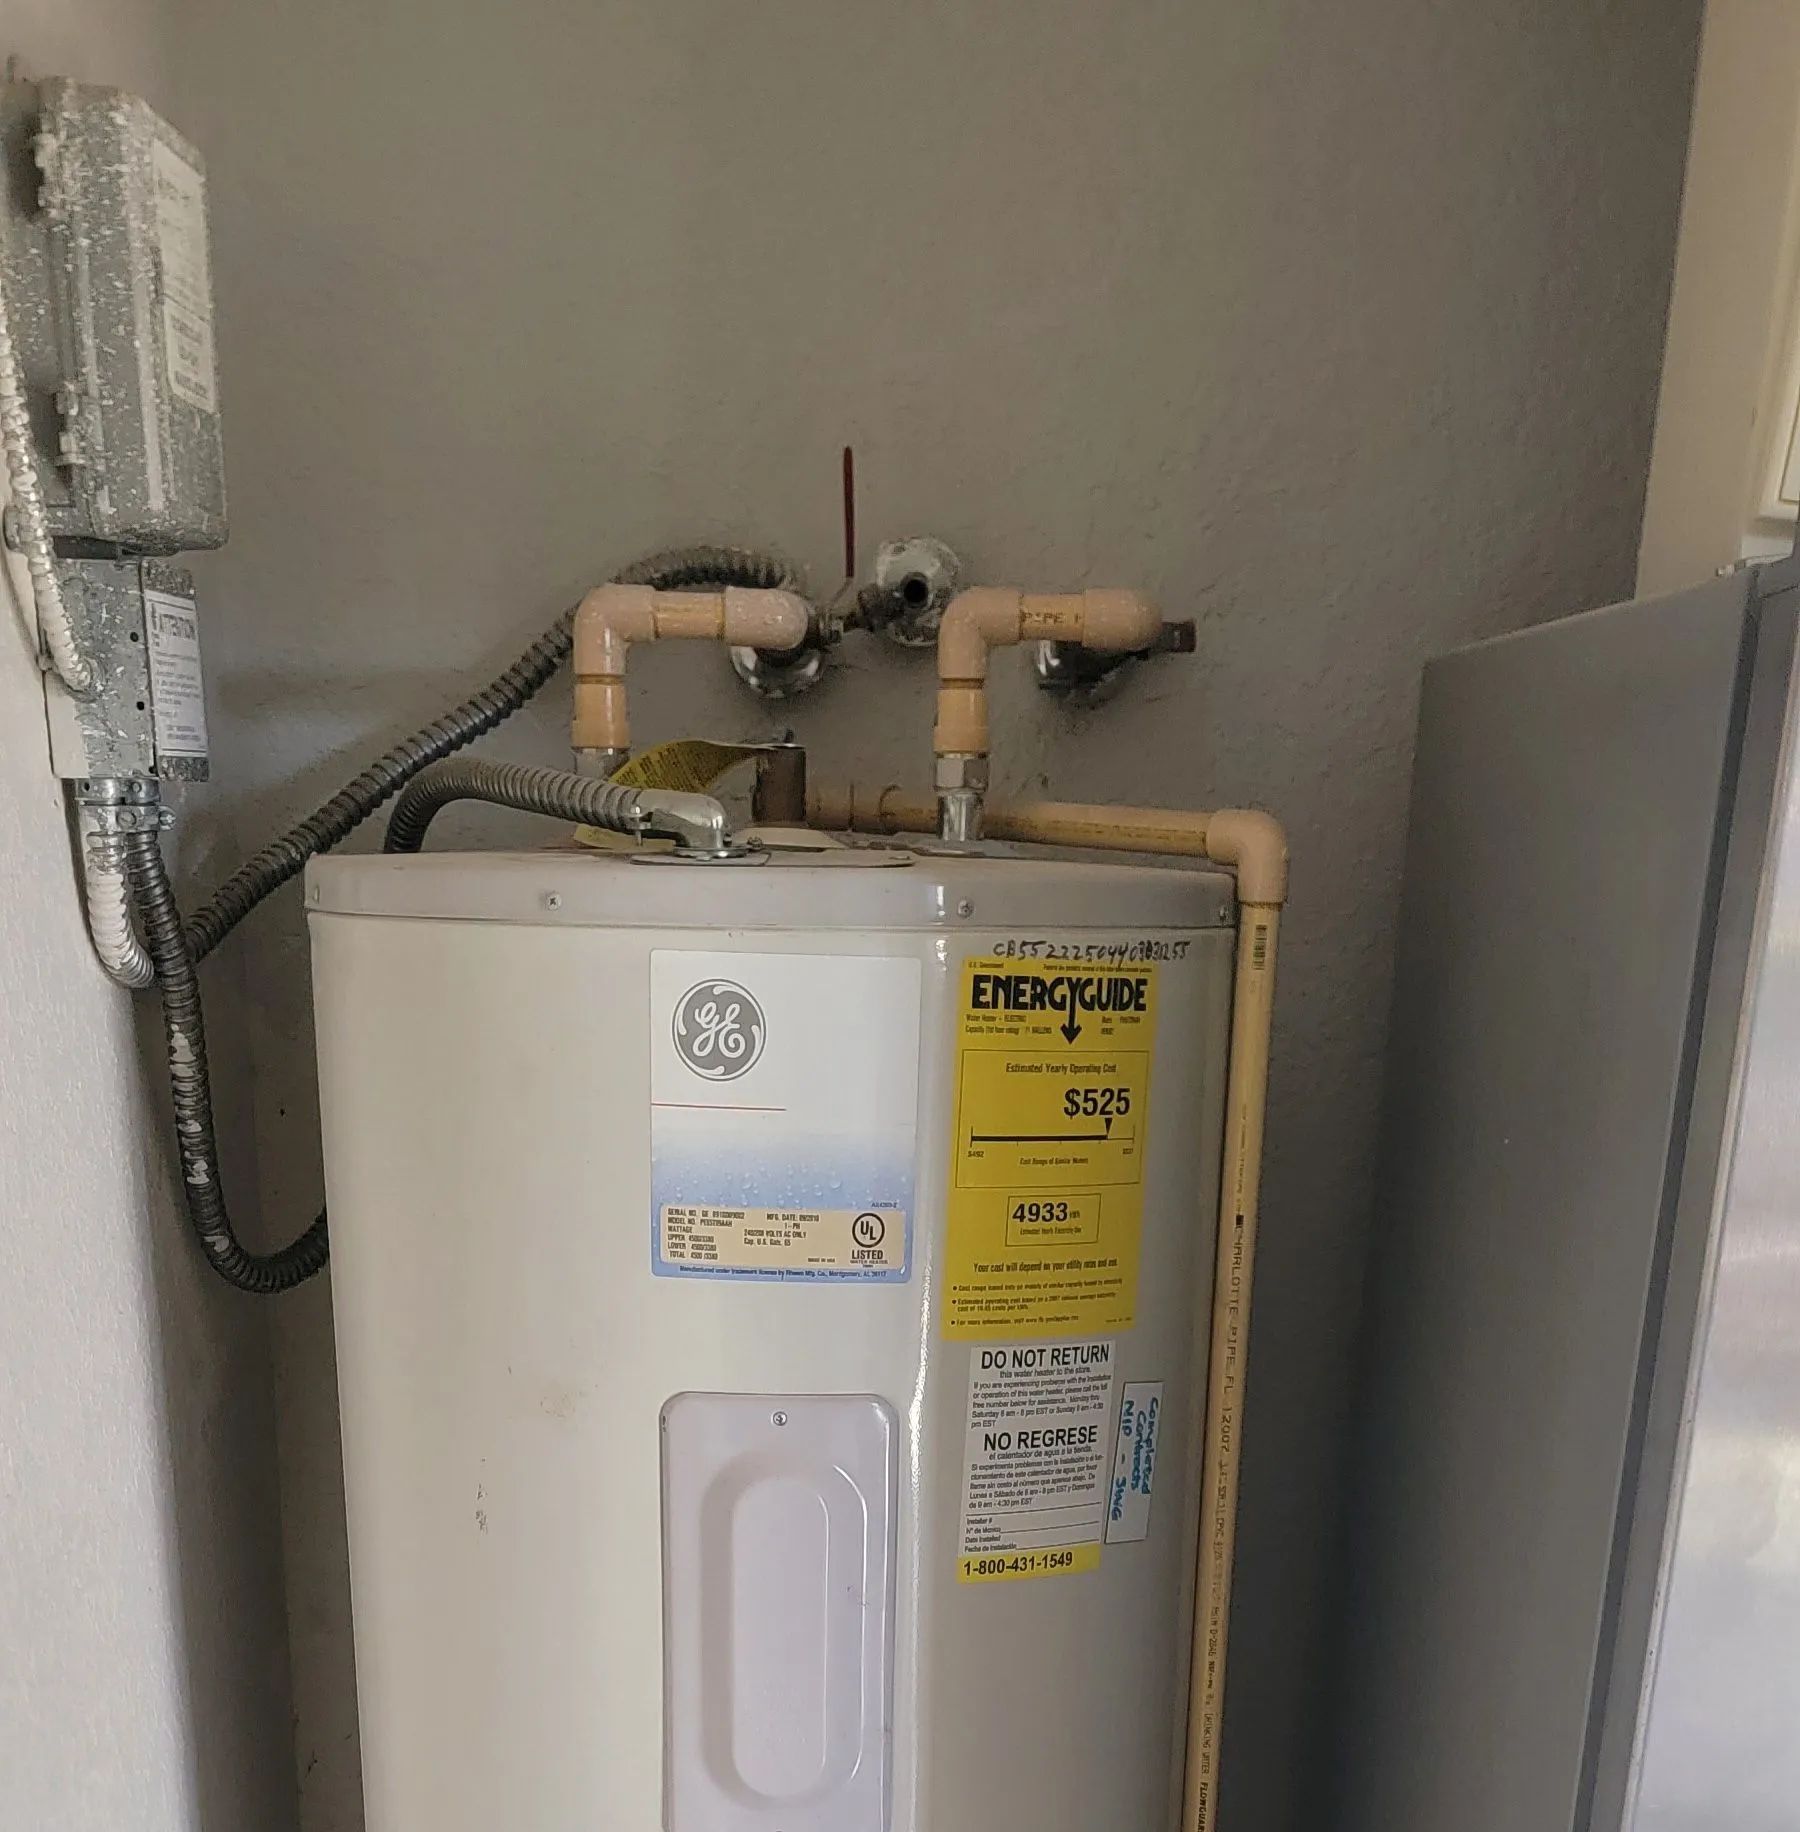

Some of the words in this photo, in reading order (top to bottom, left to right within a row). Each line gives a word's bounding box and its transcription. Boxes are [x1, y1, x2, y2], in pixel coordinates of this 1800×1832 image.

[971, 974, 1148, 1012] ENERGYGUIDE
[693, 1000, 746, 1059] GE
[1006, 1062, 1043, 1073] Estimated
[1045, 1064, 1067, 1074] Yearly
[1069, 1064, 1100, 1074] Operating
[1103, 1064, 1117, 1073] Cost
[1064, 1087, 1131, 1120] $525
[1012, 1202, 1068, 1223] 4933
[668, 1225, 693, 1234] WATTAGE
[860, 1221, 876, 1240] UL
[668, 1234, 685, 1242] UPPER
[668, 1242, 686, 1250] LOWER
[852, 1250, 883, 1260] LISTED
[974, 1263, 989, 1273] Your
[990, 1262, 1004, 1272] cost
[1006, 1262, 1018, 1272] will
[1019, 1260, 1042, 1272] depend
[1052, 1262, 1065, 1272] your
[981, 1350, 1007, 1369] DO
[1012, 1349, 1046, 1368] NOT
[1051, 1344, 1110, 1366] RETURN
[1000, 1370, 1012, 1378] this
[1014, 1370, 1033, 1378] water
[1034, 1369, 1055, 1377] heater
[979, 1382, 991, 1391] you
[980, 1391, 1009, 1400] operation
[1010, 1390, 1017, 1398] of
[986, 1400, 1009, 1408] number
[972, 1410, 999, 1419] Saturday
[1036, 1407, 1047, 1415] EST
[983, 1420, 996, 1428] EST
[984, 1432, 1012, 1451] NO
[1018, 1425, 1098, 1449] REGRESE
[997, 1450, 1033, 1460] calentador
[1034, 1450, 1042, 1458] de
[1044, 1449, 1060, 1458] agua
[1056, 1485, 1067, 1493] EST
[1021, 1498, 1032, 1506] EST
[965, 1545, 981, 1553] Fecha
[964, 1551, 1073, 1576] 1-800-431-1549
